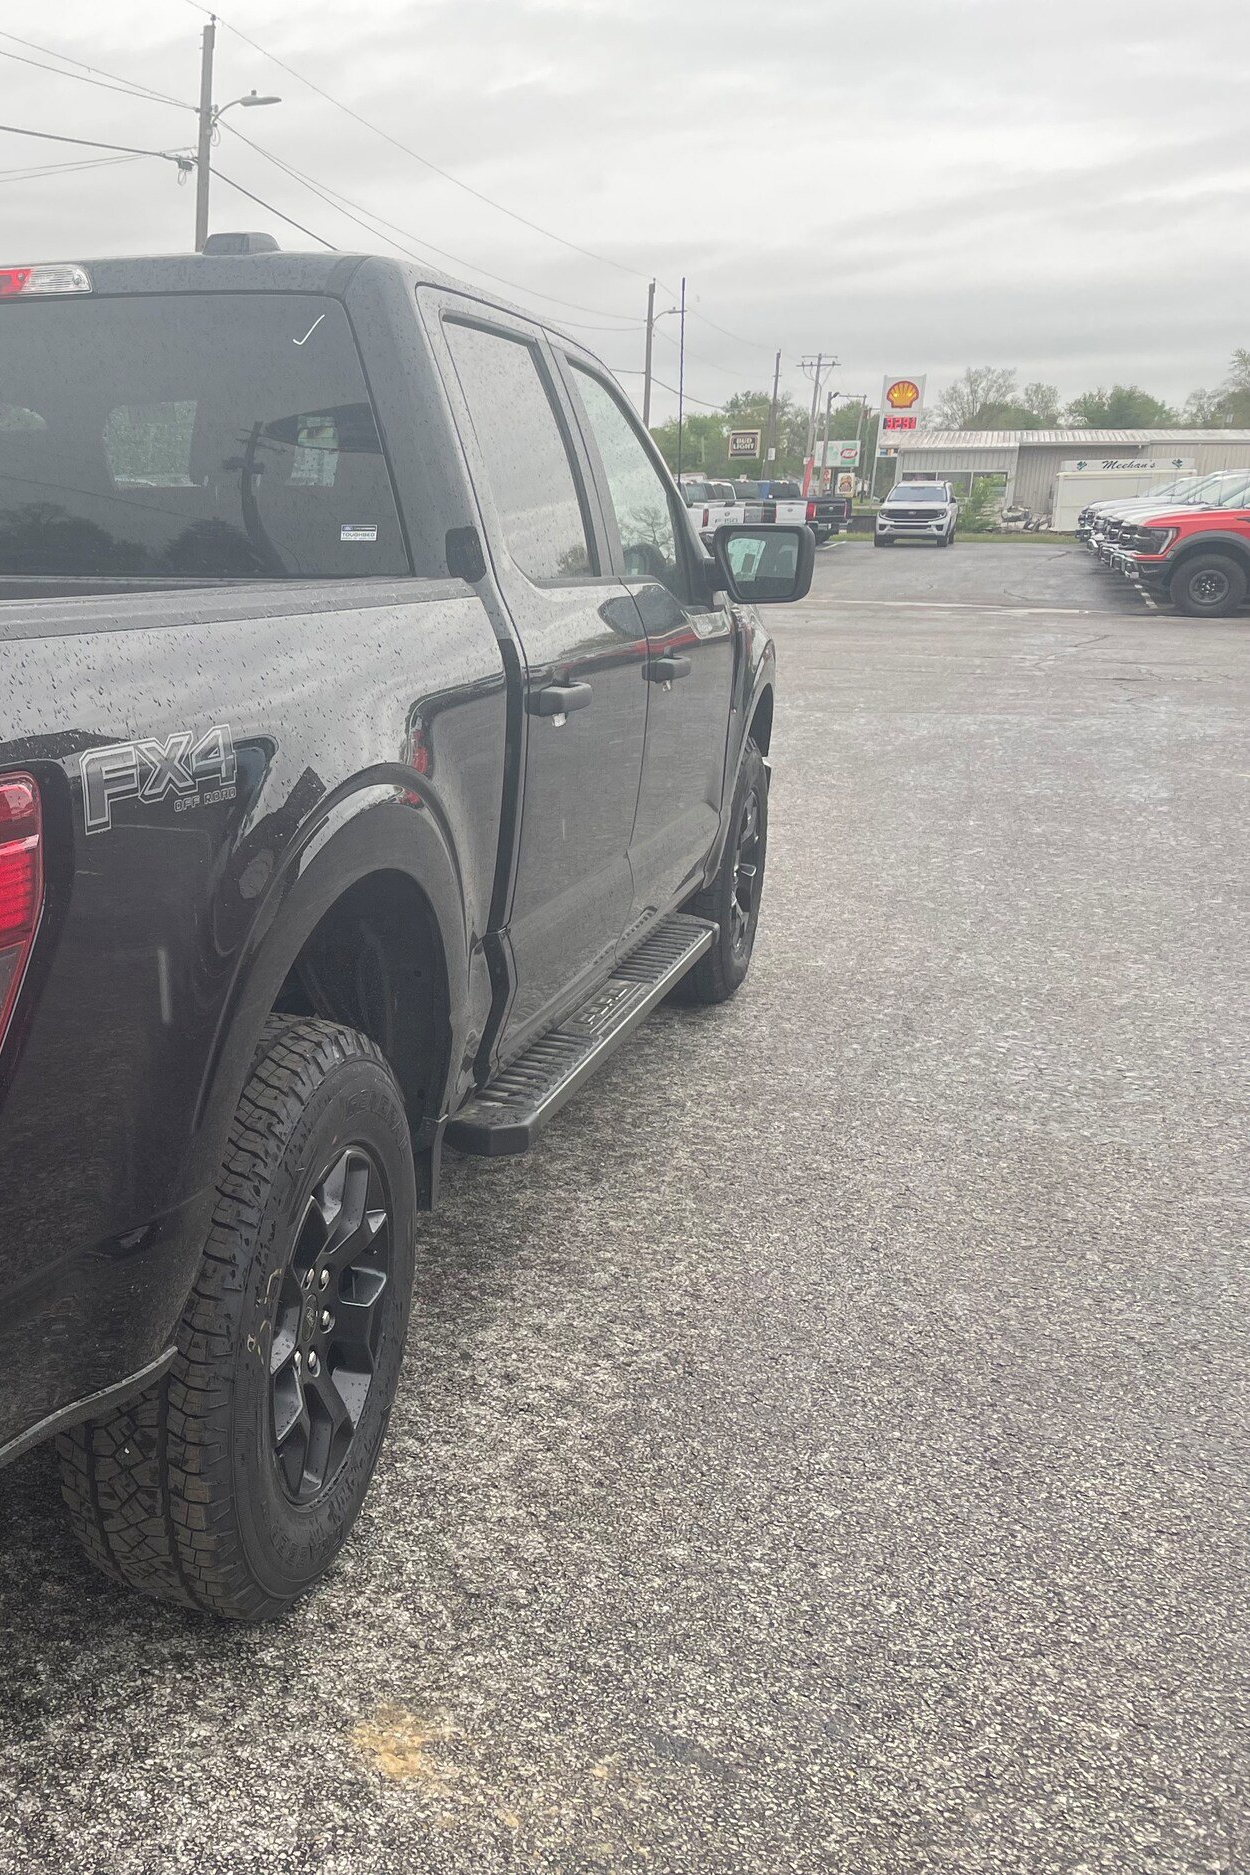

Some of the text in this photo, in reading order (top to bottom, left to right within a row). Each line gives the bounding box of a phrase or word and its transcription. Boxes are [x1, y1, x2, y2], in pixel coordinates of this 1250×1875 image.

[1101, 460, 1156, 470] Meehan's
[79, 724, 238, 836] FX4
[173, 786, 237, 813] OFF ROAD
